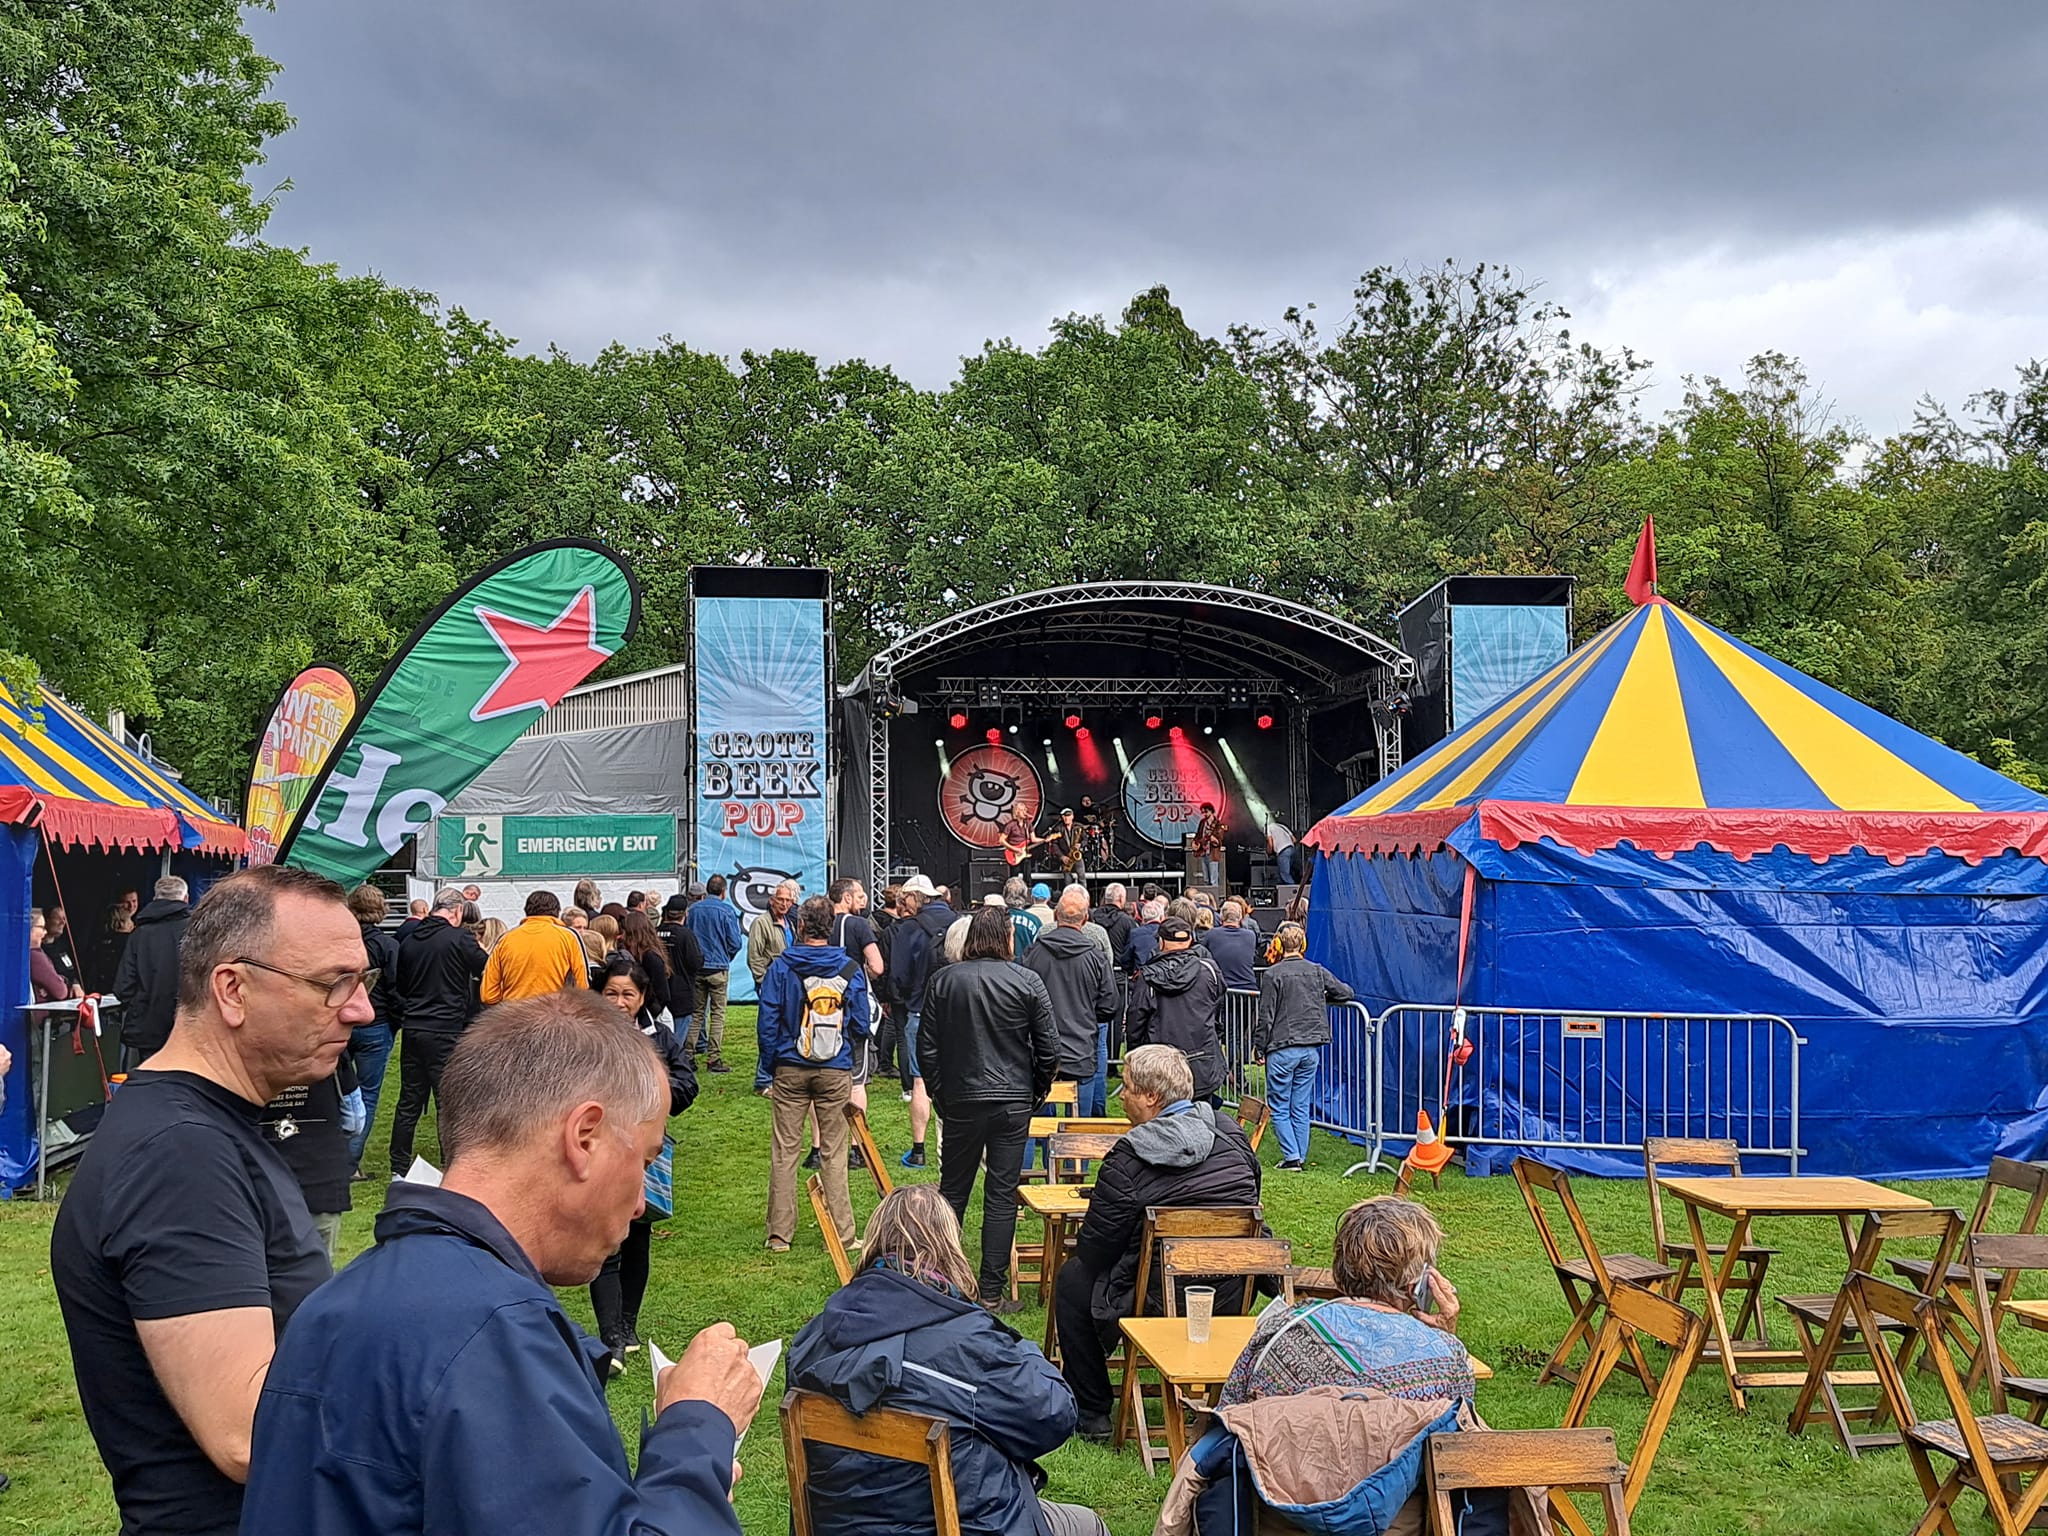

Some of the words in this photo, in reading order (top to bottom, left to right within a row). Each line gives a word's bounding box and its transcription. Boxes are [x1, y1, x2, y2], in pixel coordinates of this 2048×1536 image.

[709, 731, 814, 758] GROTE
[701, 760, 821, 799] BEEK
[1144, 784, 1203, 804] BEEK
[721, 801, 804, 837] POP
[1153, 804, 1194, 823] POP
[517, 837, 618, 853] EMERGENCY
[622, 836, 658, 851] EXIT
